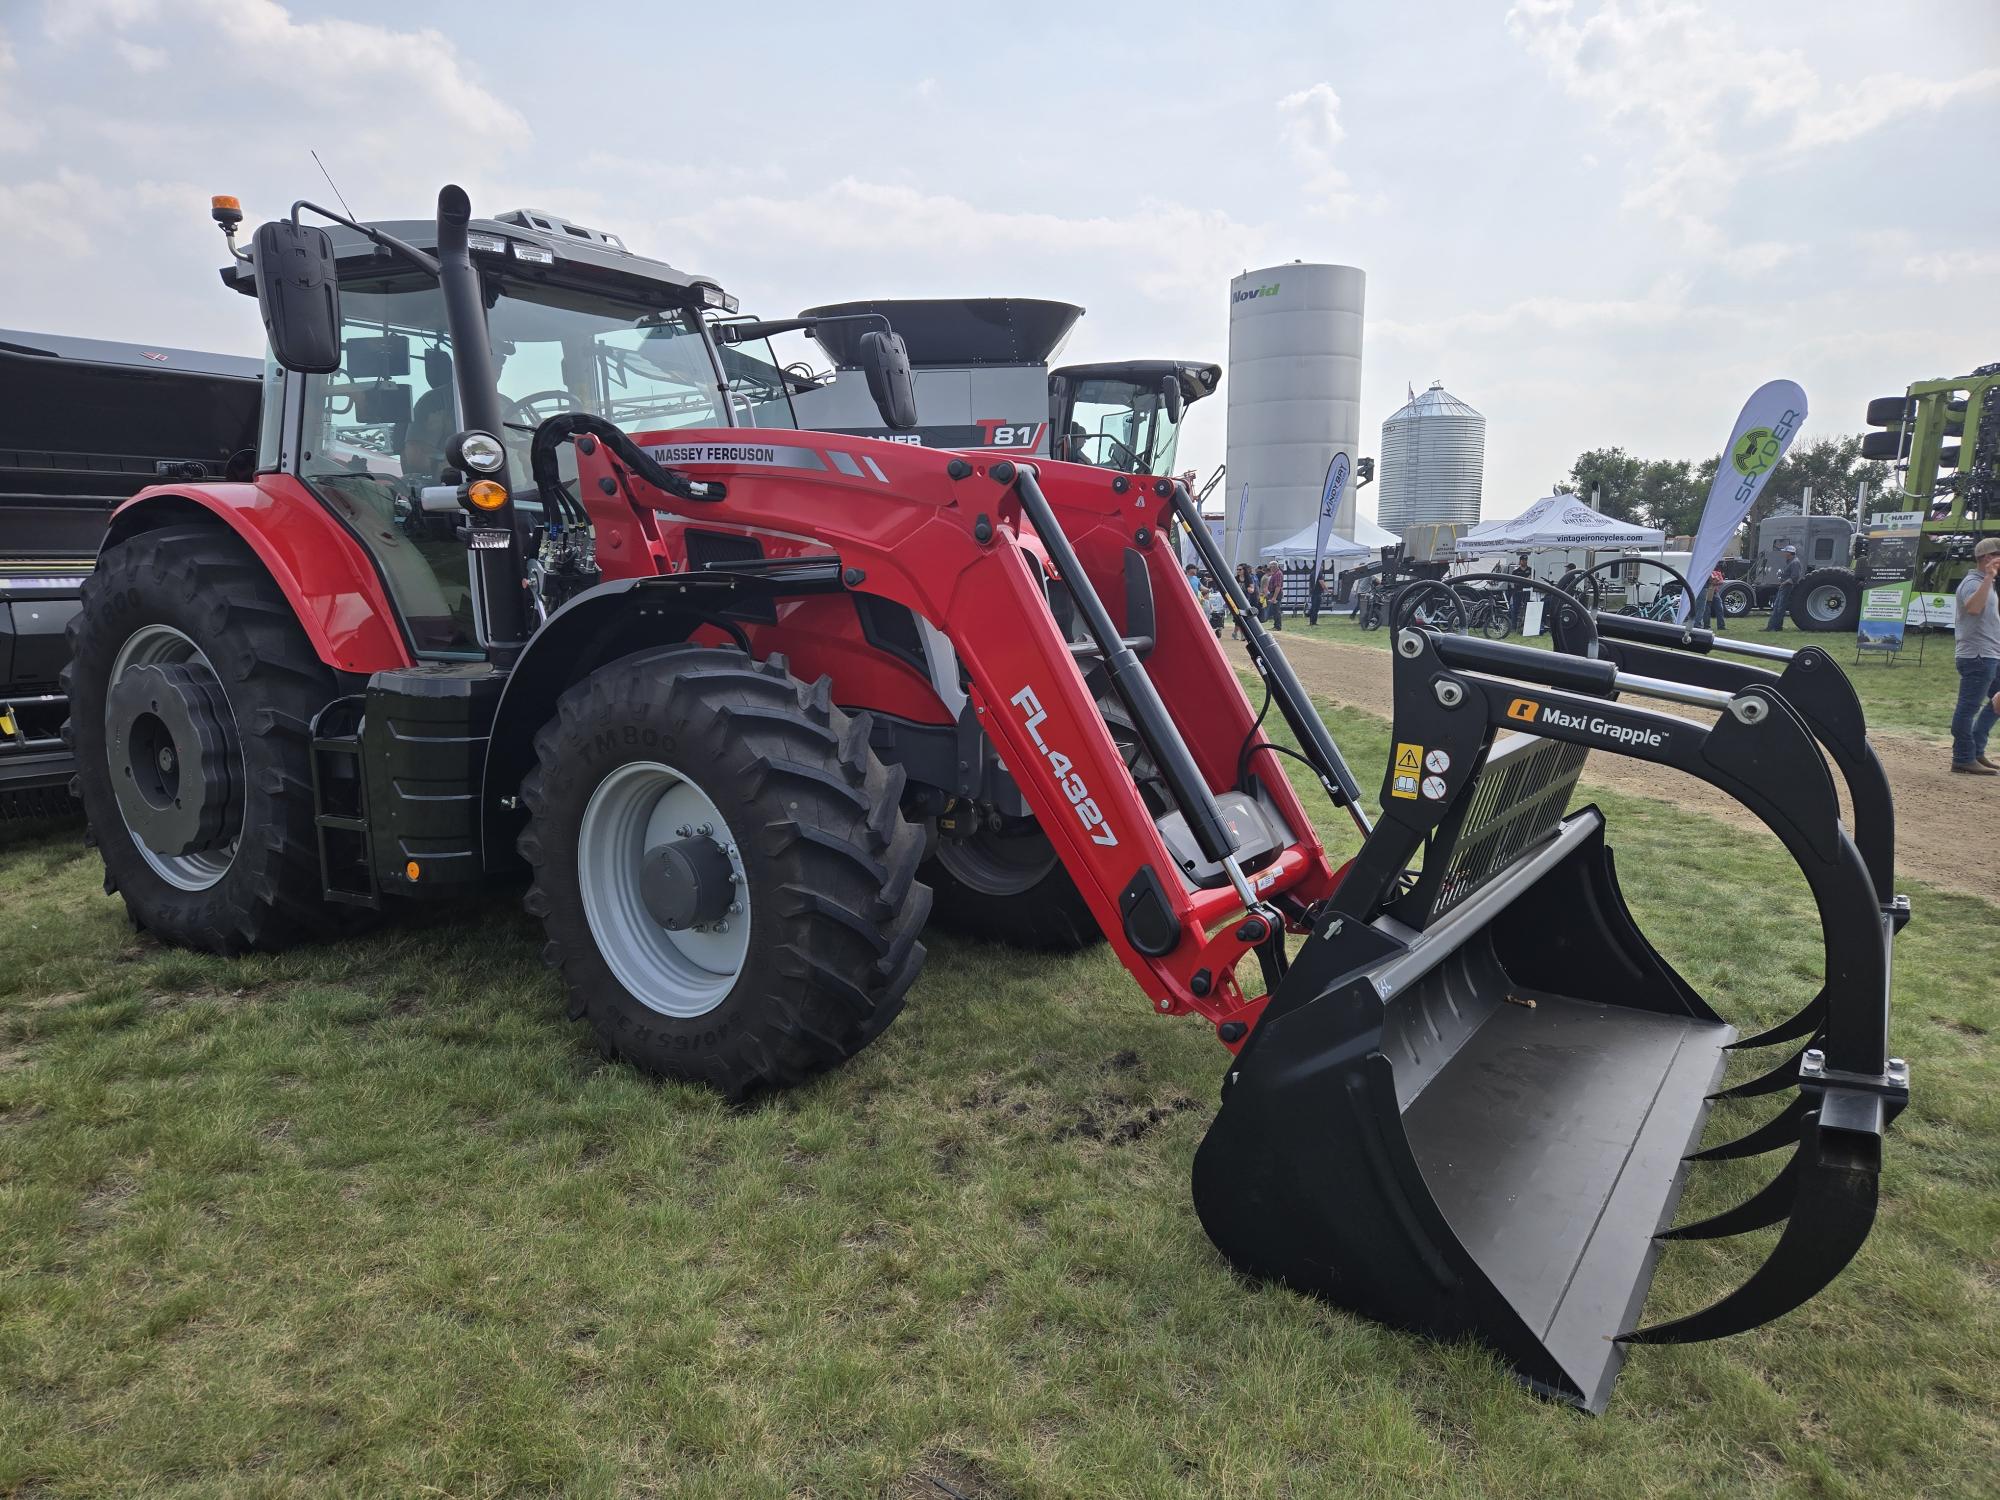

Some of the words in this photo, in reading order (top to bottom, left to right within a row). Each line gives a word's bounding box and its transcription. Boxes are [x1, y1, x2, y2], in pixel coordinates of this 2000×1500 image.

[1232, 283, 1280, 304] Novid
[976, 419, 1031, 445] T81
[655, 447, 703, 462] MASSEY
[707, 447, 774, 462] FERGUSON
[1734, 409, 1800, 504] SPYDER
[1556, 534, 1643, 542] vintageironcycles.com
[1542, 707, 1587, 730] Maxi
[1010, 684, 1119, 847] FL.4327
